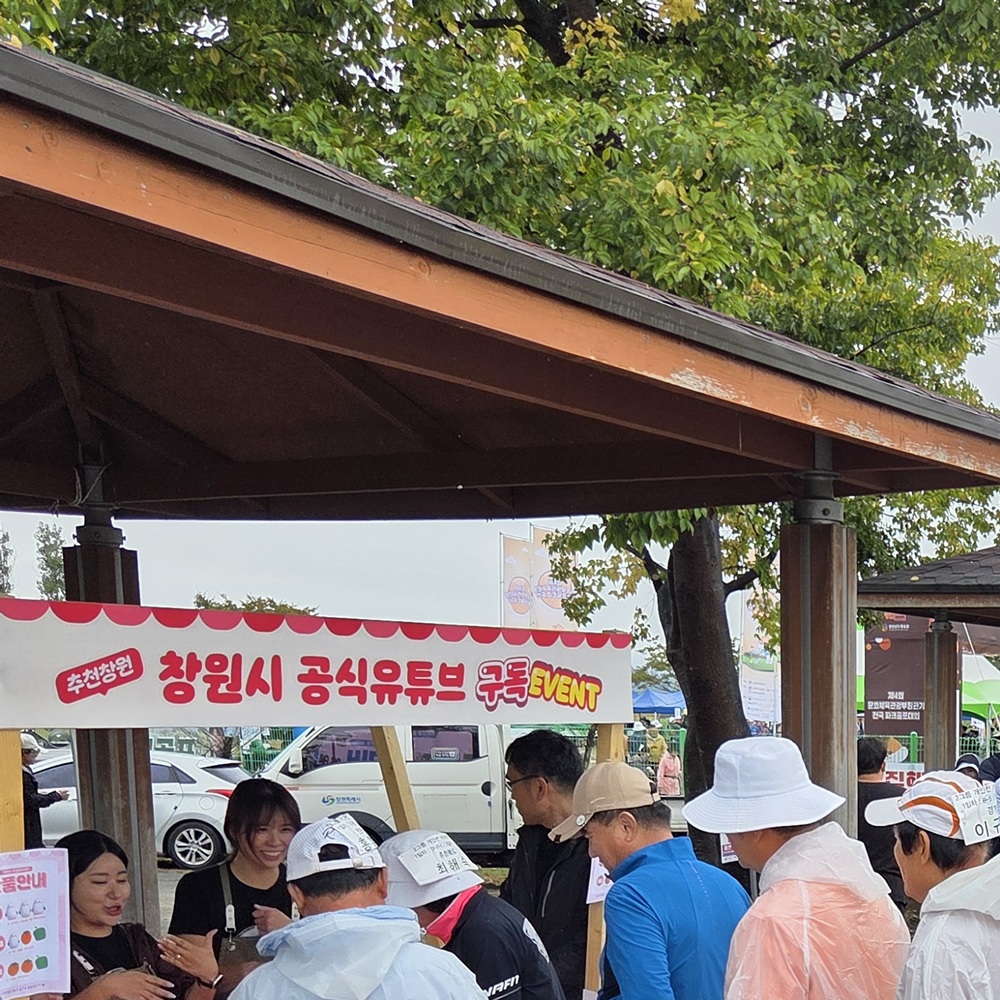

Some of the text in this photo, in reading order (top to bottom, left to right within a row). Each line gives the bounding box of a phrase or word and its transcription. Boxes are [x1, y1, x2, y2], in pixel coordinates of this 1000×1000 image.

[67, 654, 134, 694] 추천창원
[158, 650, 283, 704] 창원시
[297, 655, 466, 705] 공식유튜브
[0, 871, 48, 895] 품안내
